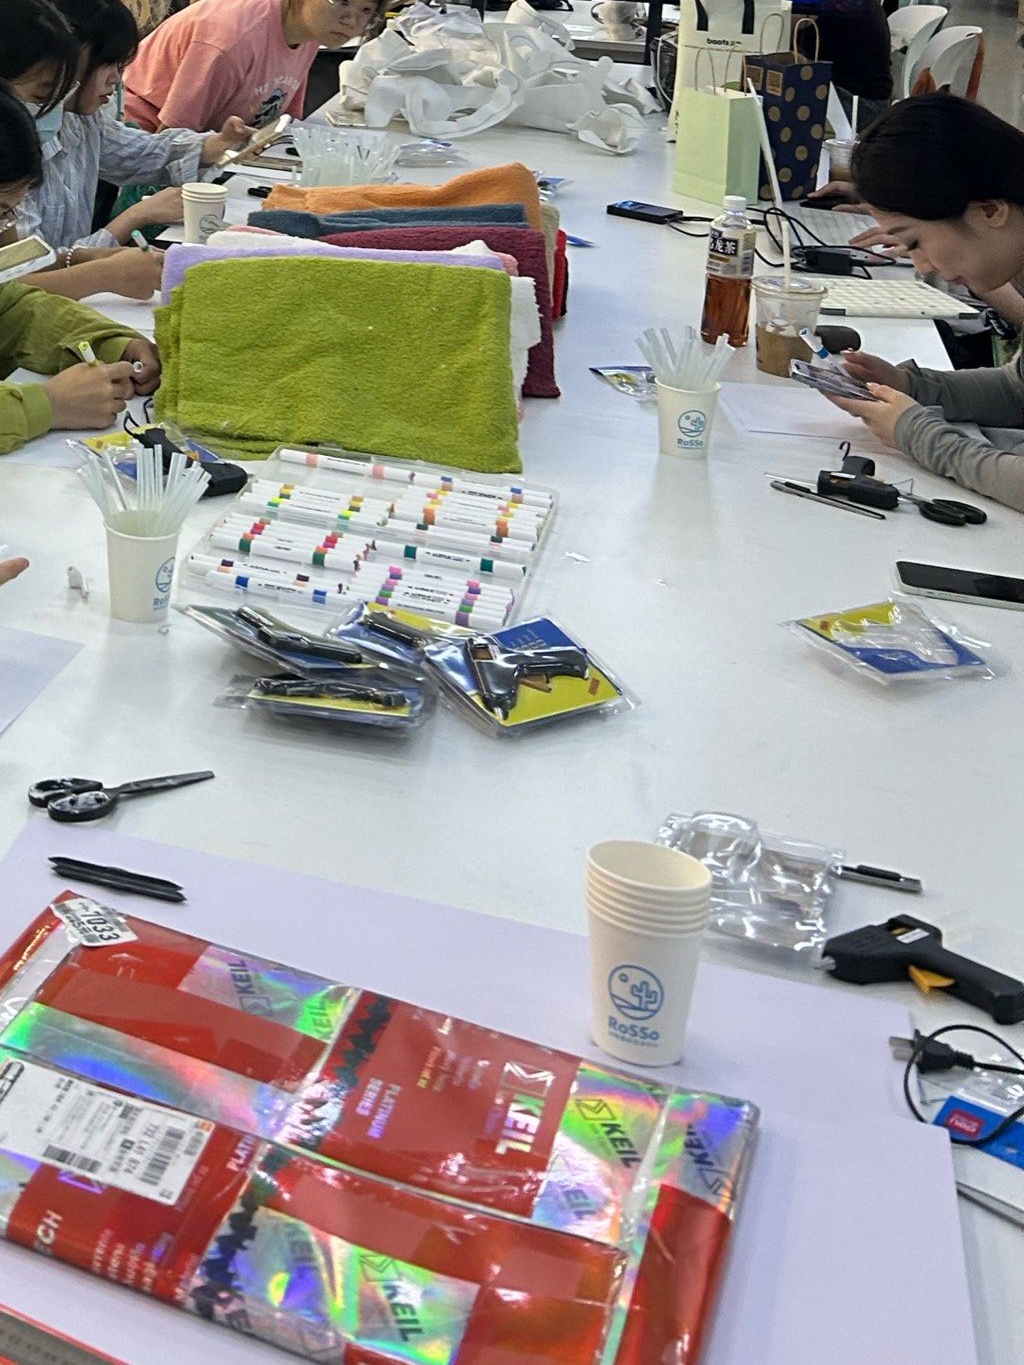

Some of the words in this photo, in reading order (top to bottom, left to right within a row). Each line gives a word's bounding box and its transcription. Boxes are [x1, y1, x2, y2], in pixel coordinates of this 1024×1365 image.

[81, 911, 120, 941] 7033
[227, 960, 255, 994] KEIL
[608, 1015, 660, 1041] RoSSo
[494, 1092, 546, 1155] KEIL
[601, 1123, 642, 1168] KEIL
[563, 1189, 599, 1220] EIL
